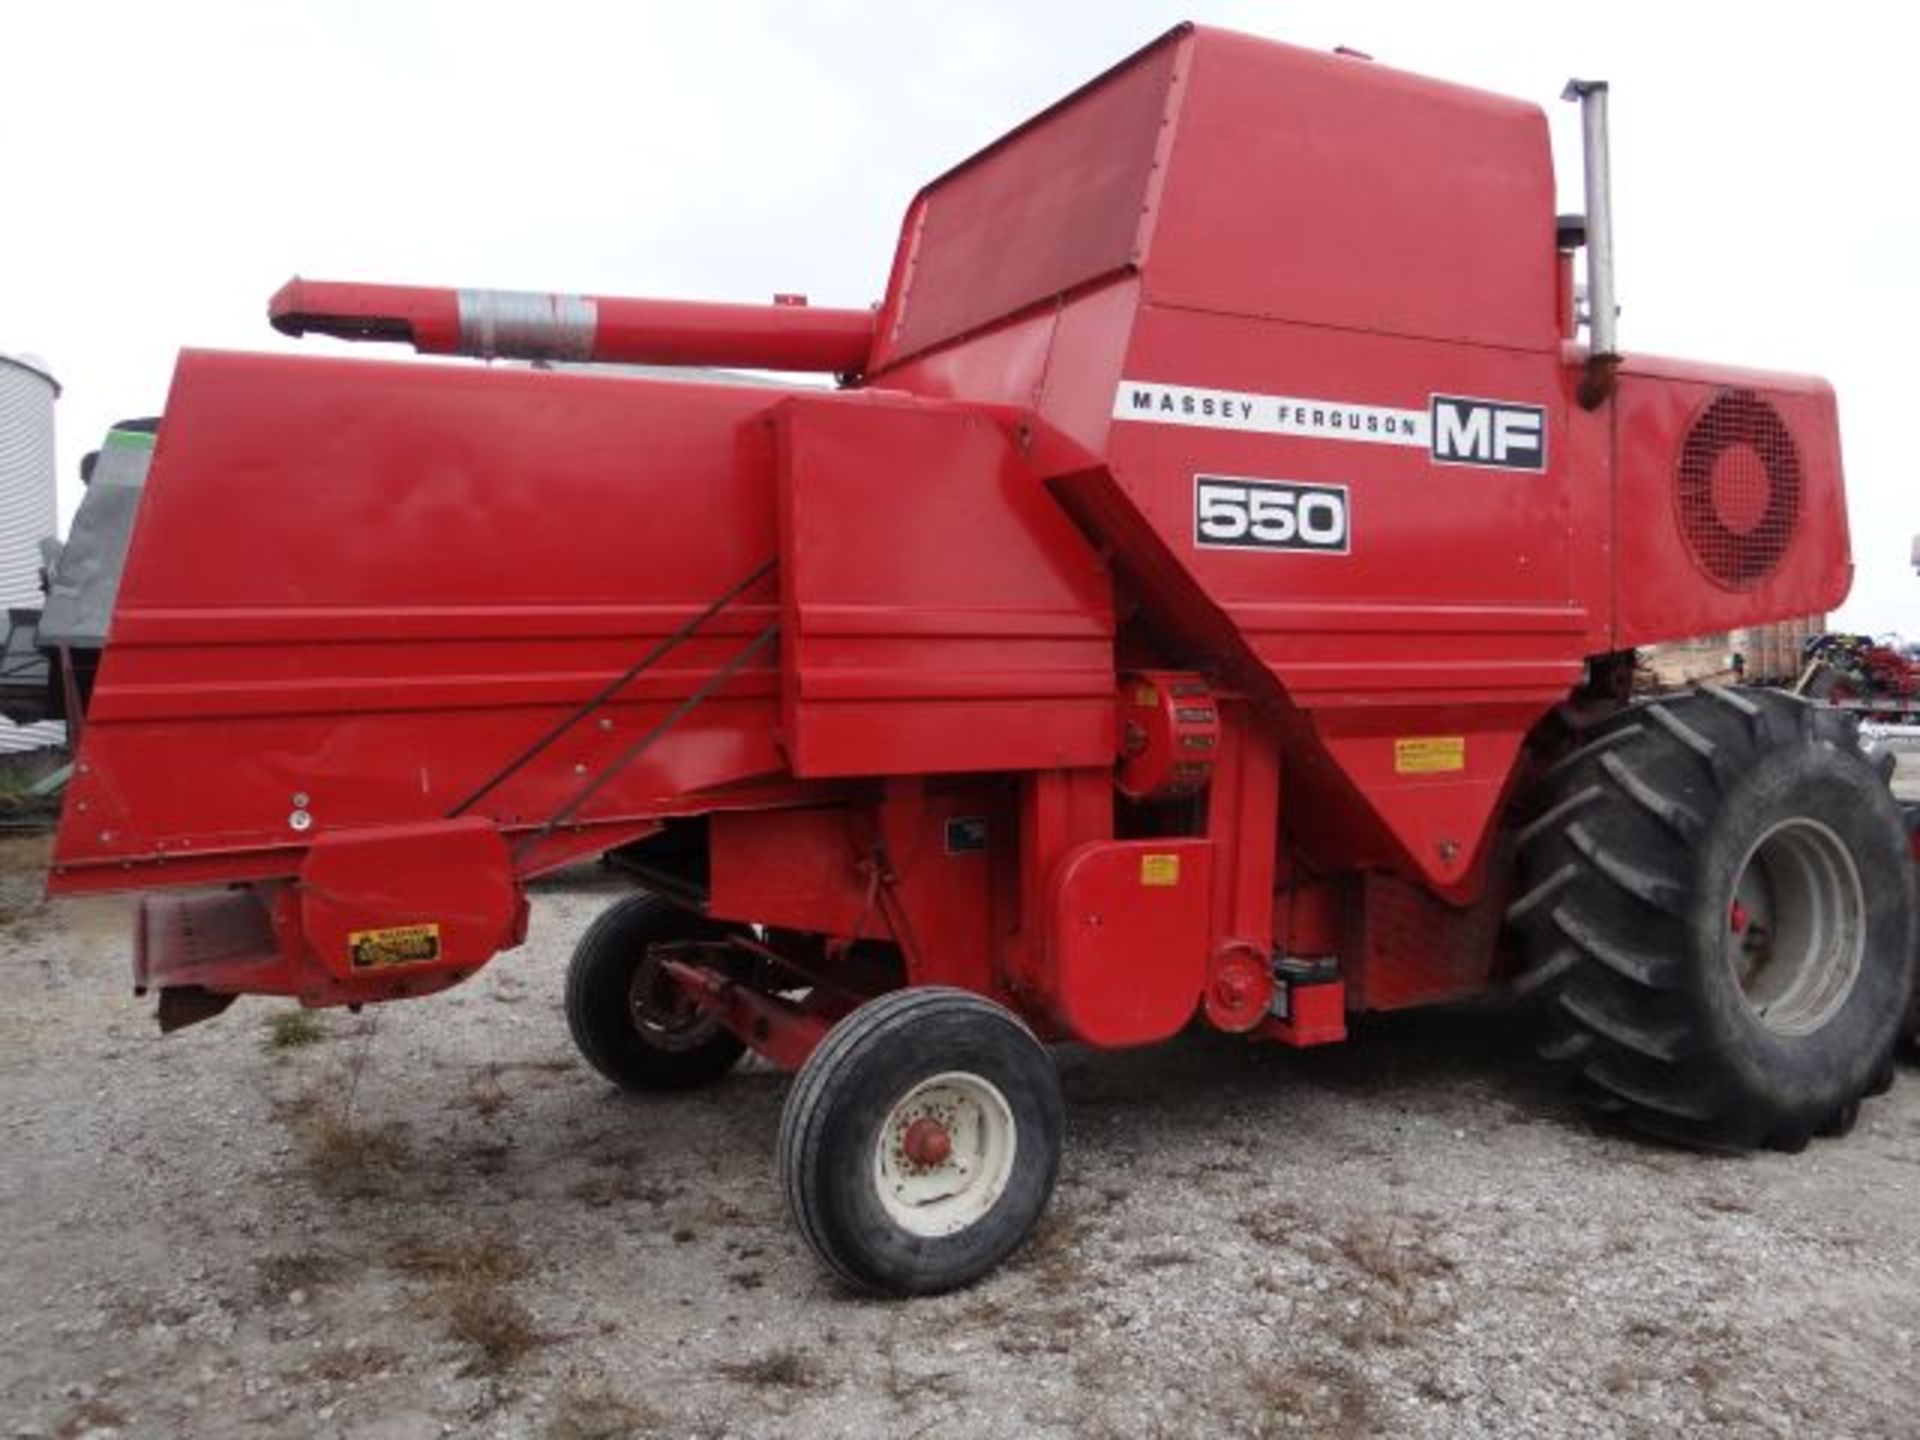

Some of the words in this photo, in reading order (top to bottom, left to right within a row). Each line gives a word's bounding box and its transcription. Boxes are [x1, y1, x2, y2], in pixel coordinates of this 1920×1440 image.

[1132, 390, 1252, 420] MASSEY
[1277, 406, 1416, 436] FERGUSON
[1435, 403, 1541, 460] MF
[1199, 485, 1345, 544] 550
